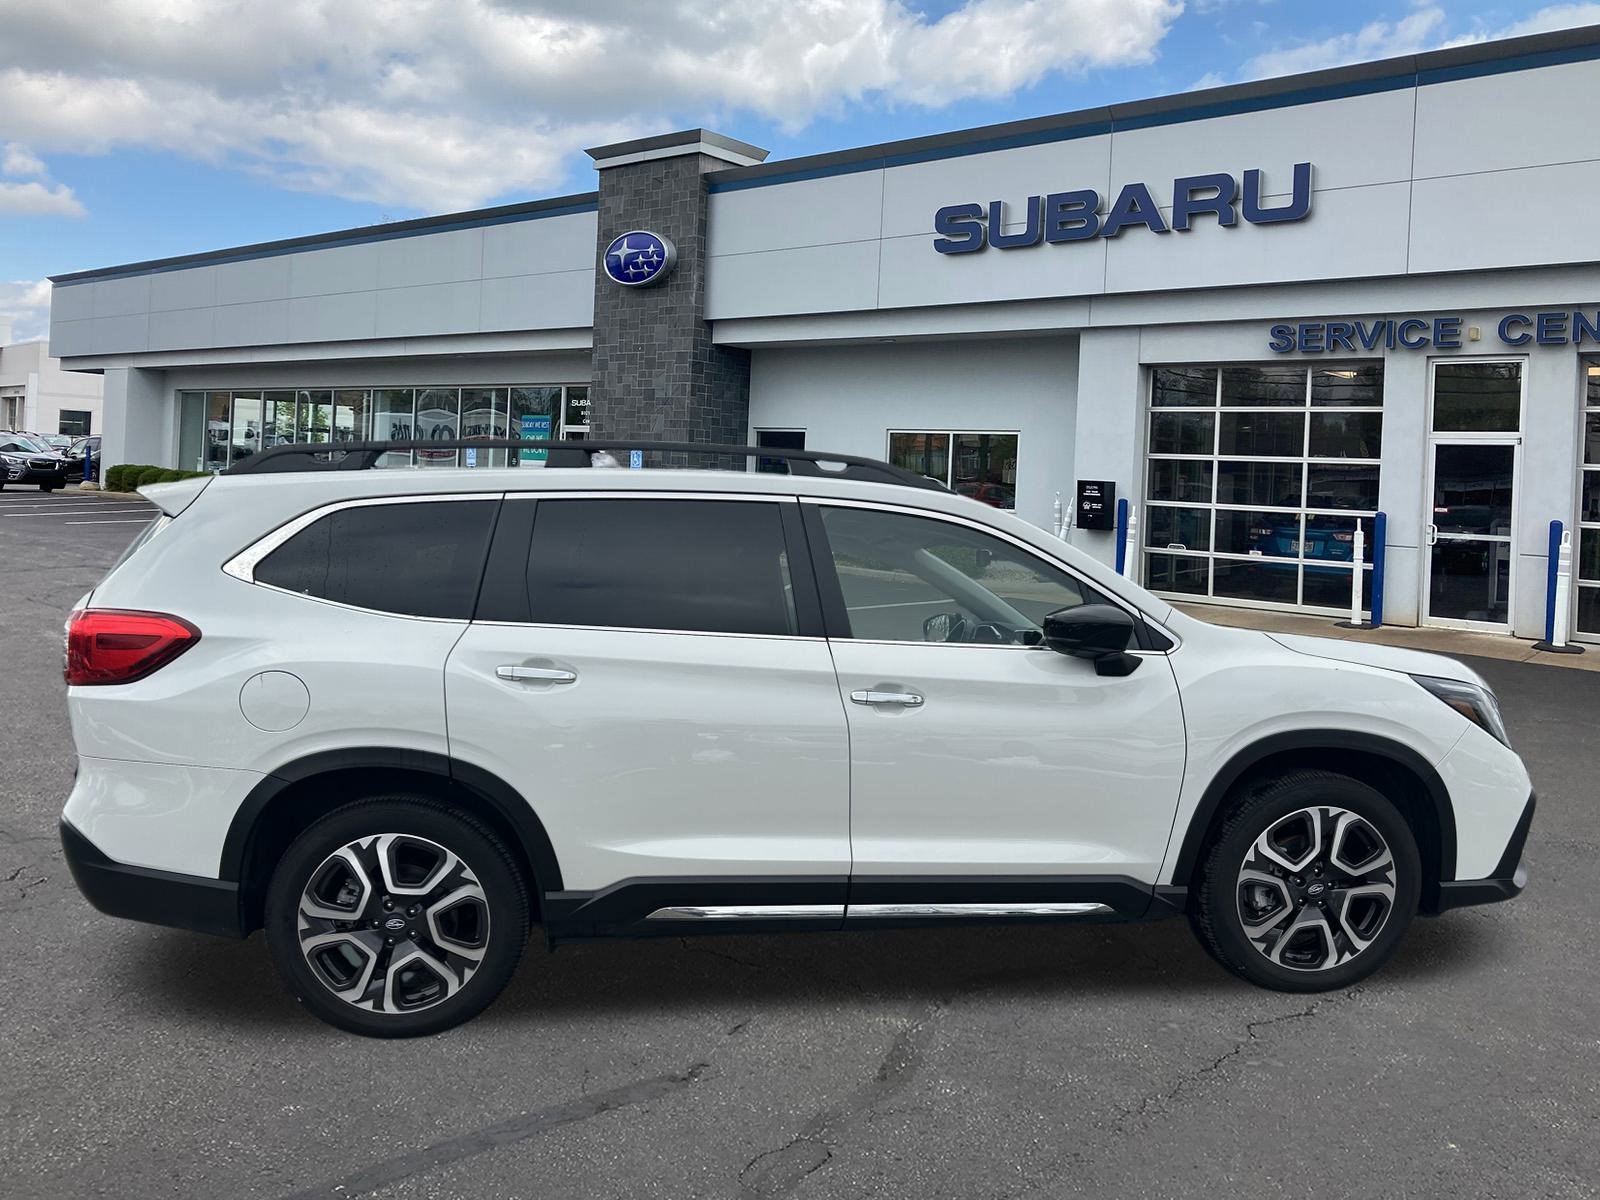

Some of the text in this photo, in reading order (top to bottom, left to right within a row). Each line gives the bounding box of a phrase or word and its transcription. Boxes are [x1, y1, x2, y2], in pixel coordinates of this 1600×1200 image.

[933, 162, 1313, 255] SUBARU
[1268, 311, 1600, 352] SERVICE CEN
